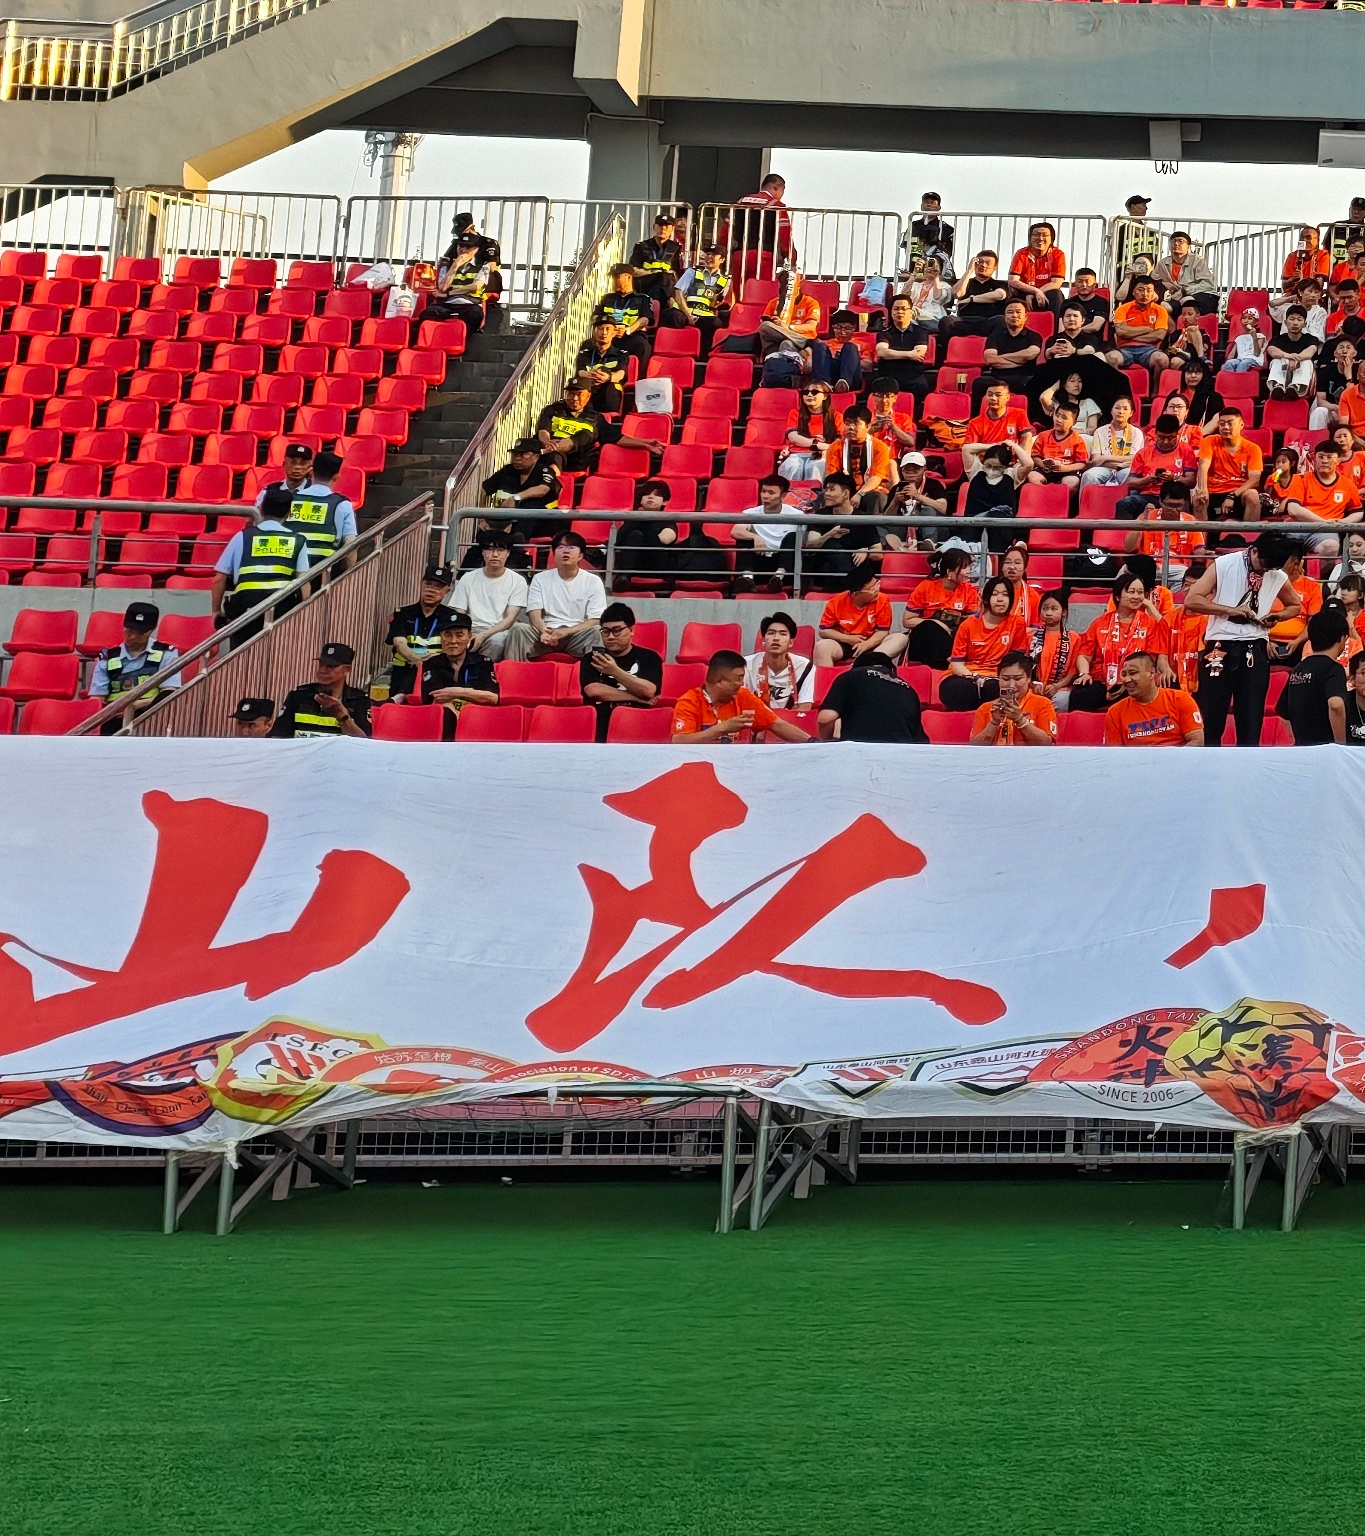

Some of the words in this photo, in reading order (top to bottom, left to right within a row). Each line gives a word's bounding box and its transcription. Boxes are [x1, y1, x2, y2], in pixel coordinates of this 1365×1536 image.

[255, 545, 294, 555] POLICE
[1055, 1012, 1157, 1061] SHANDONG
[1097, 1083, 1139, 1104] SINCE
[1142, 1087, 1176, 1104] 2006
